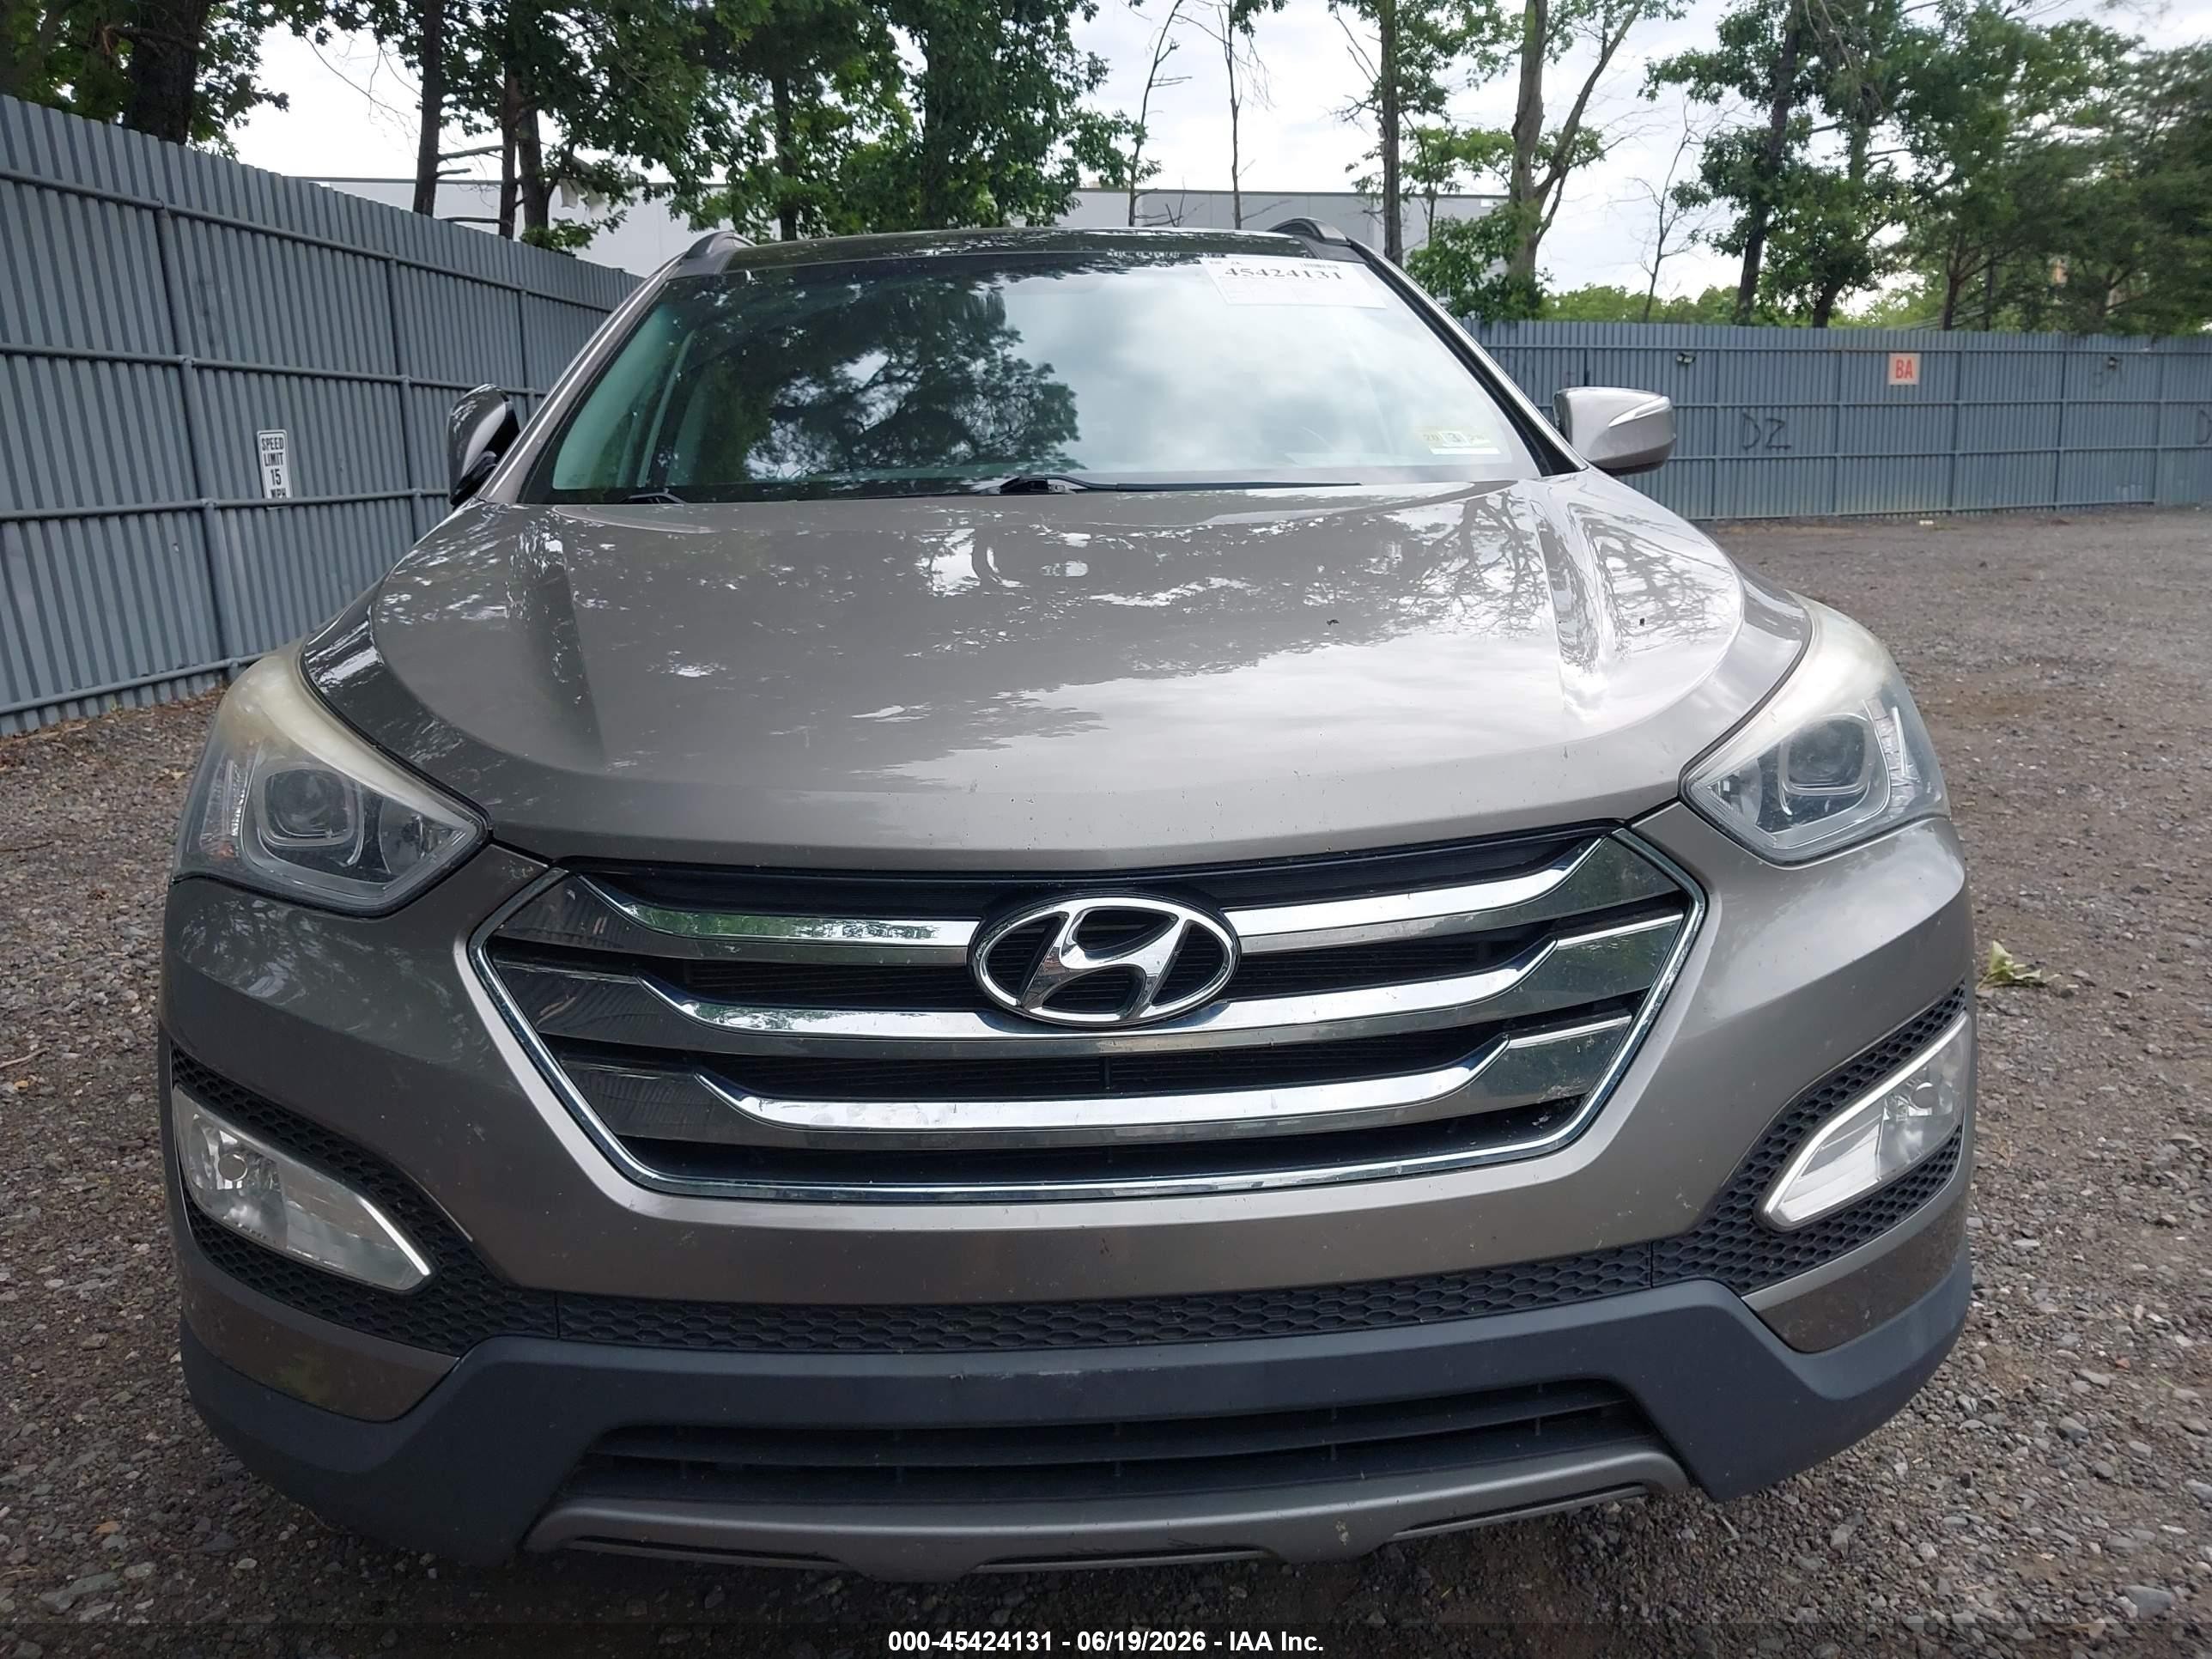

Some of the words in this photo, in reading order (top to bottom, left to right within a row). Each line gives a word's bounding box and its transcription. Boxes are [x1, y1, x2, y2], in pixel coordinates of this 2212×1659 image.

[1224, 267, 1342, 280] 45424131
[1895, 359, 1913, 379] BA
[262, 437, 284, 451] SPEED
[264, 453, 283, 466] LIMIT
[270, 468, 282, 486] 15
